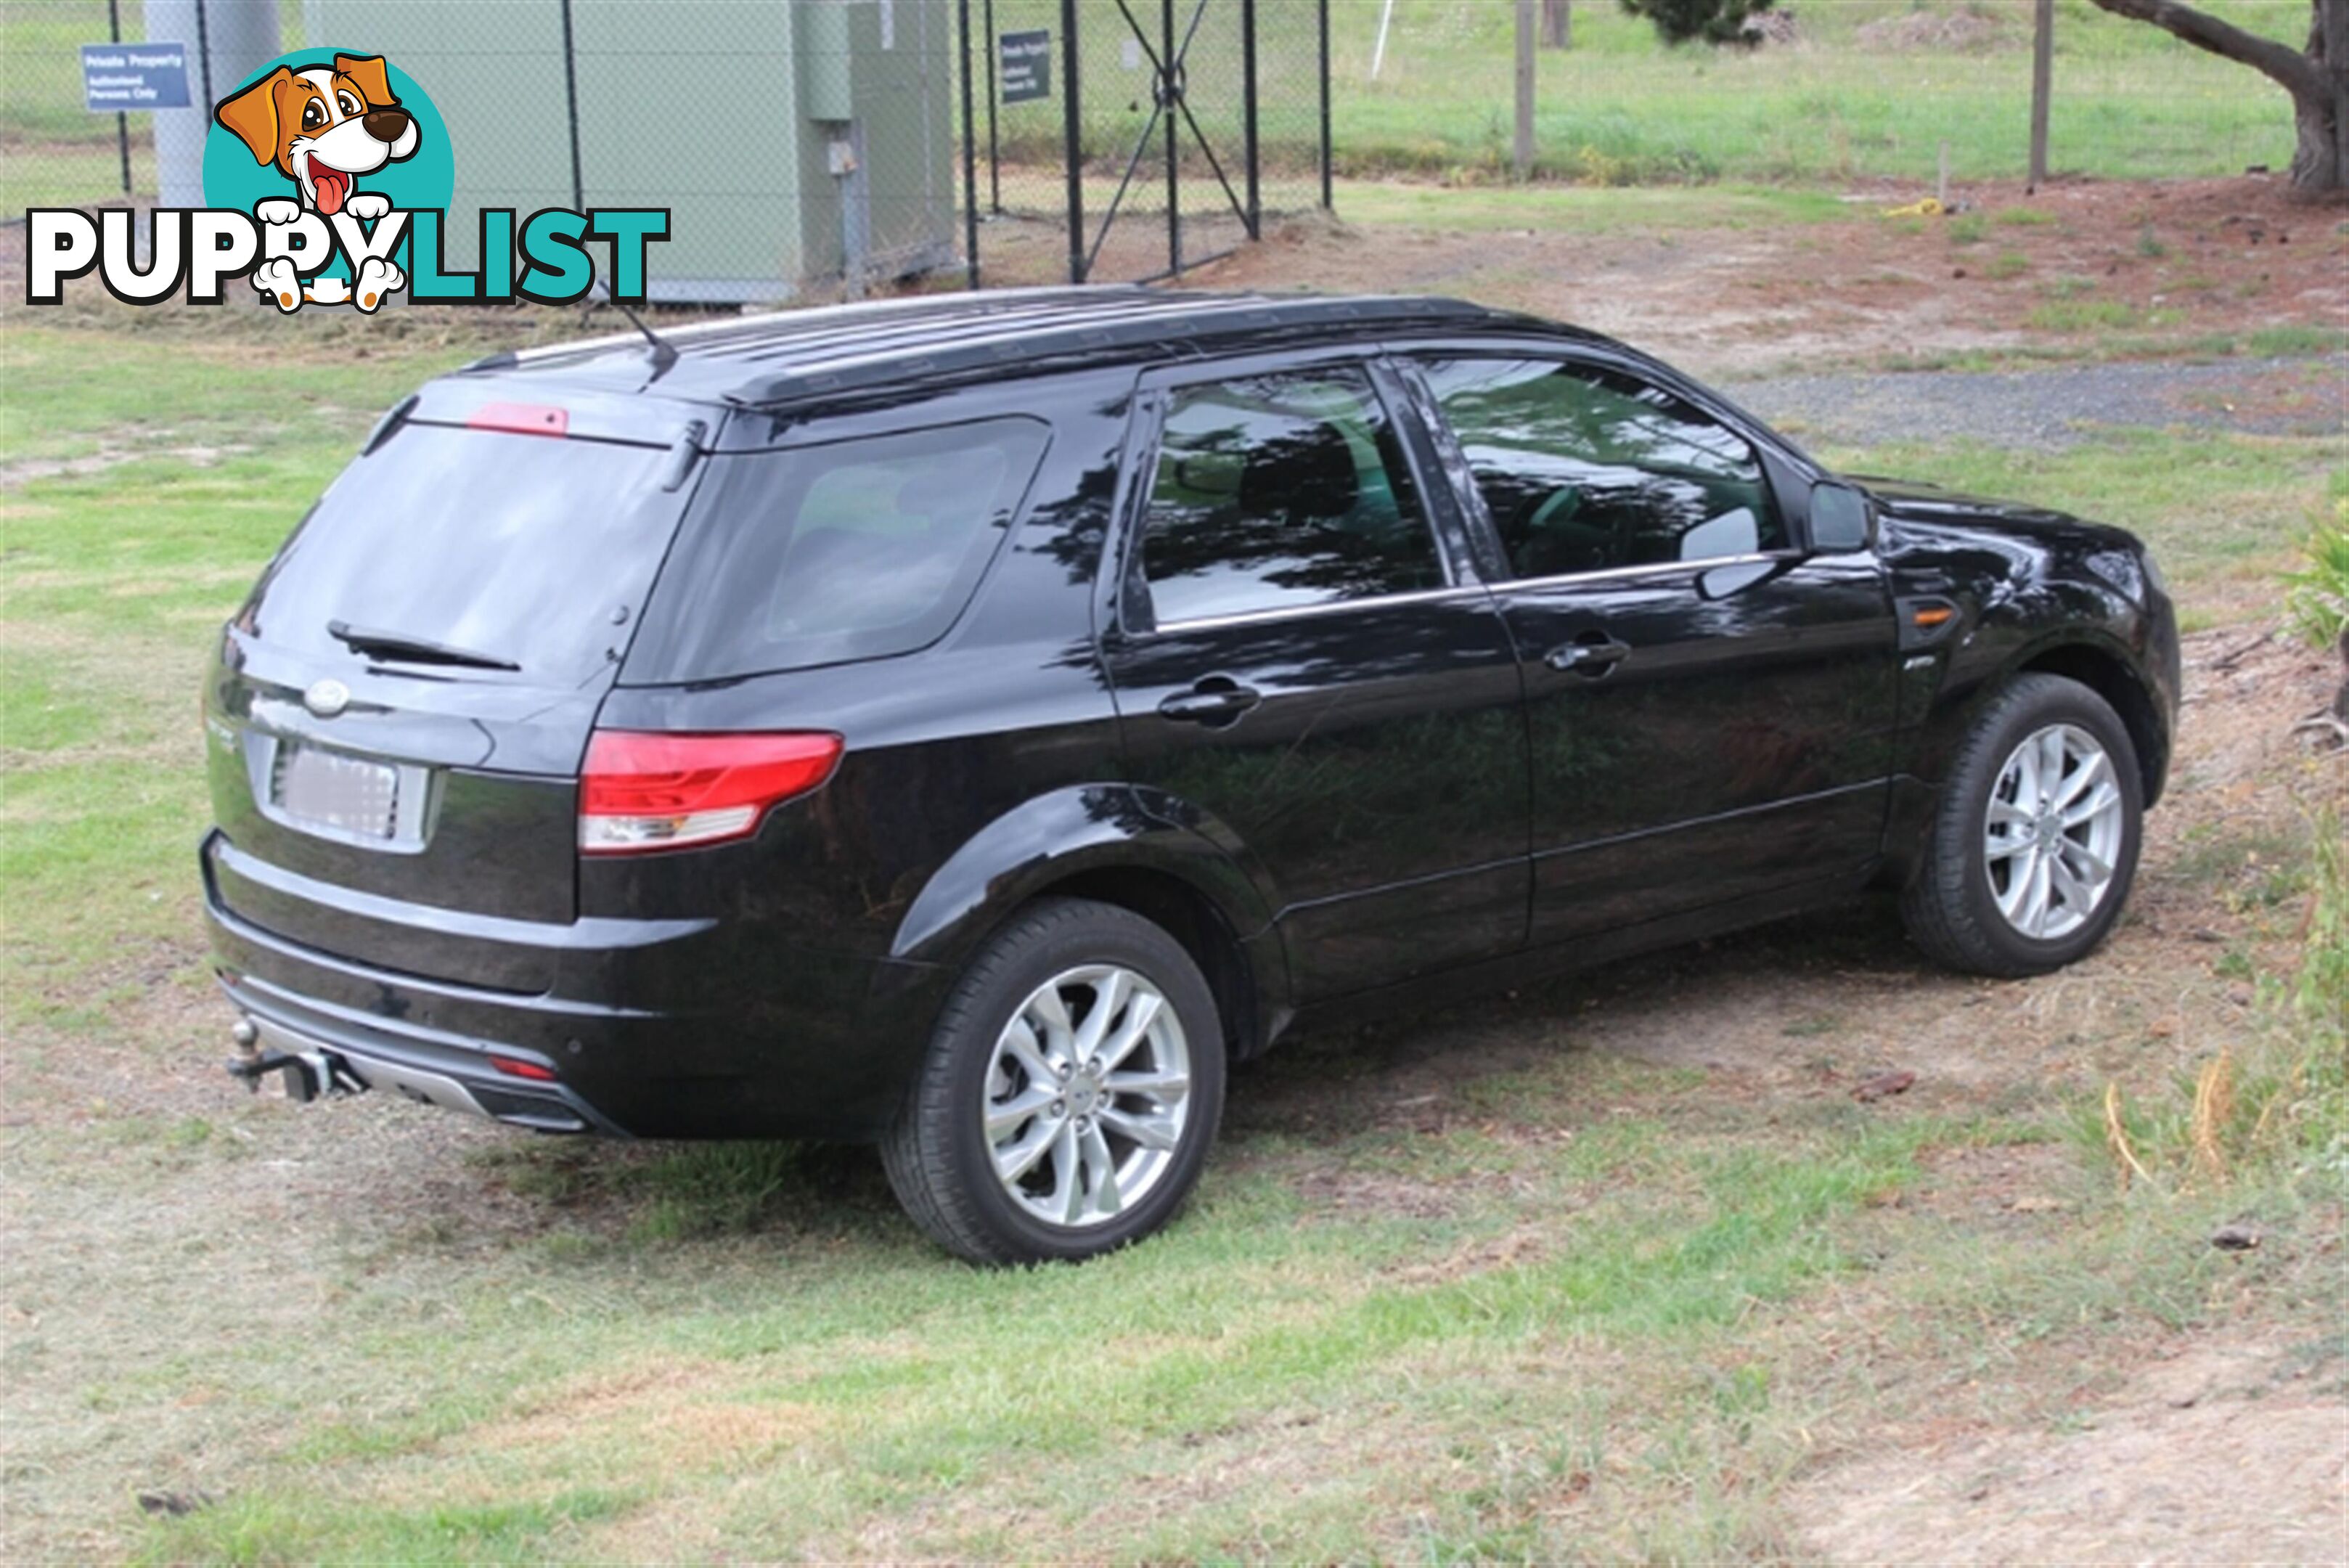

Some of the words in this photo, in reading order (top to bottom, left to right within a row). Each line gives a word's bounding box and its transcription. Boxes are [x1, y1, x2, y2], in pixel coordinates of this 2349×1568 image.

[85, 54, 126, 68] Private
[128, 53, 181, 69] Property
[132, 87, 158, 100] Only
